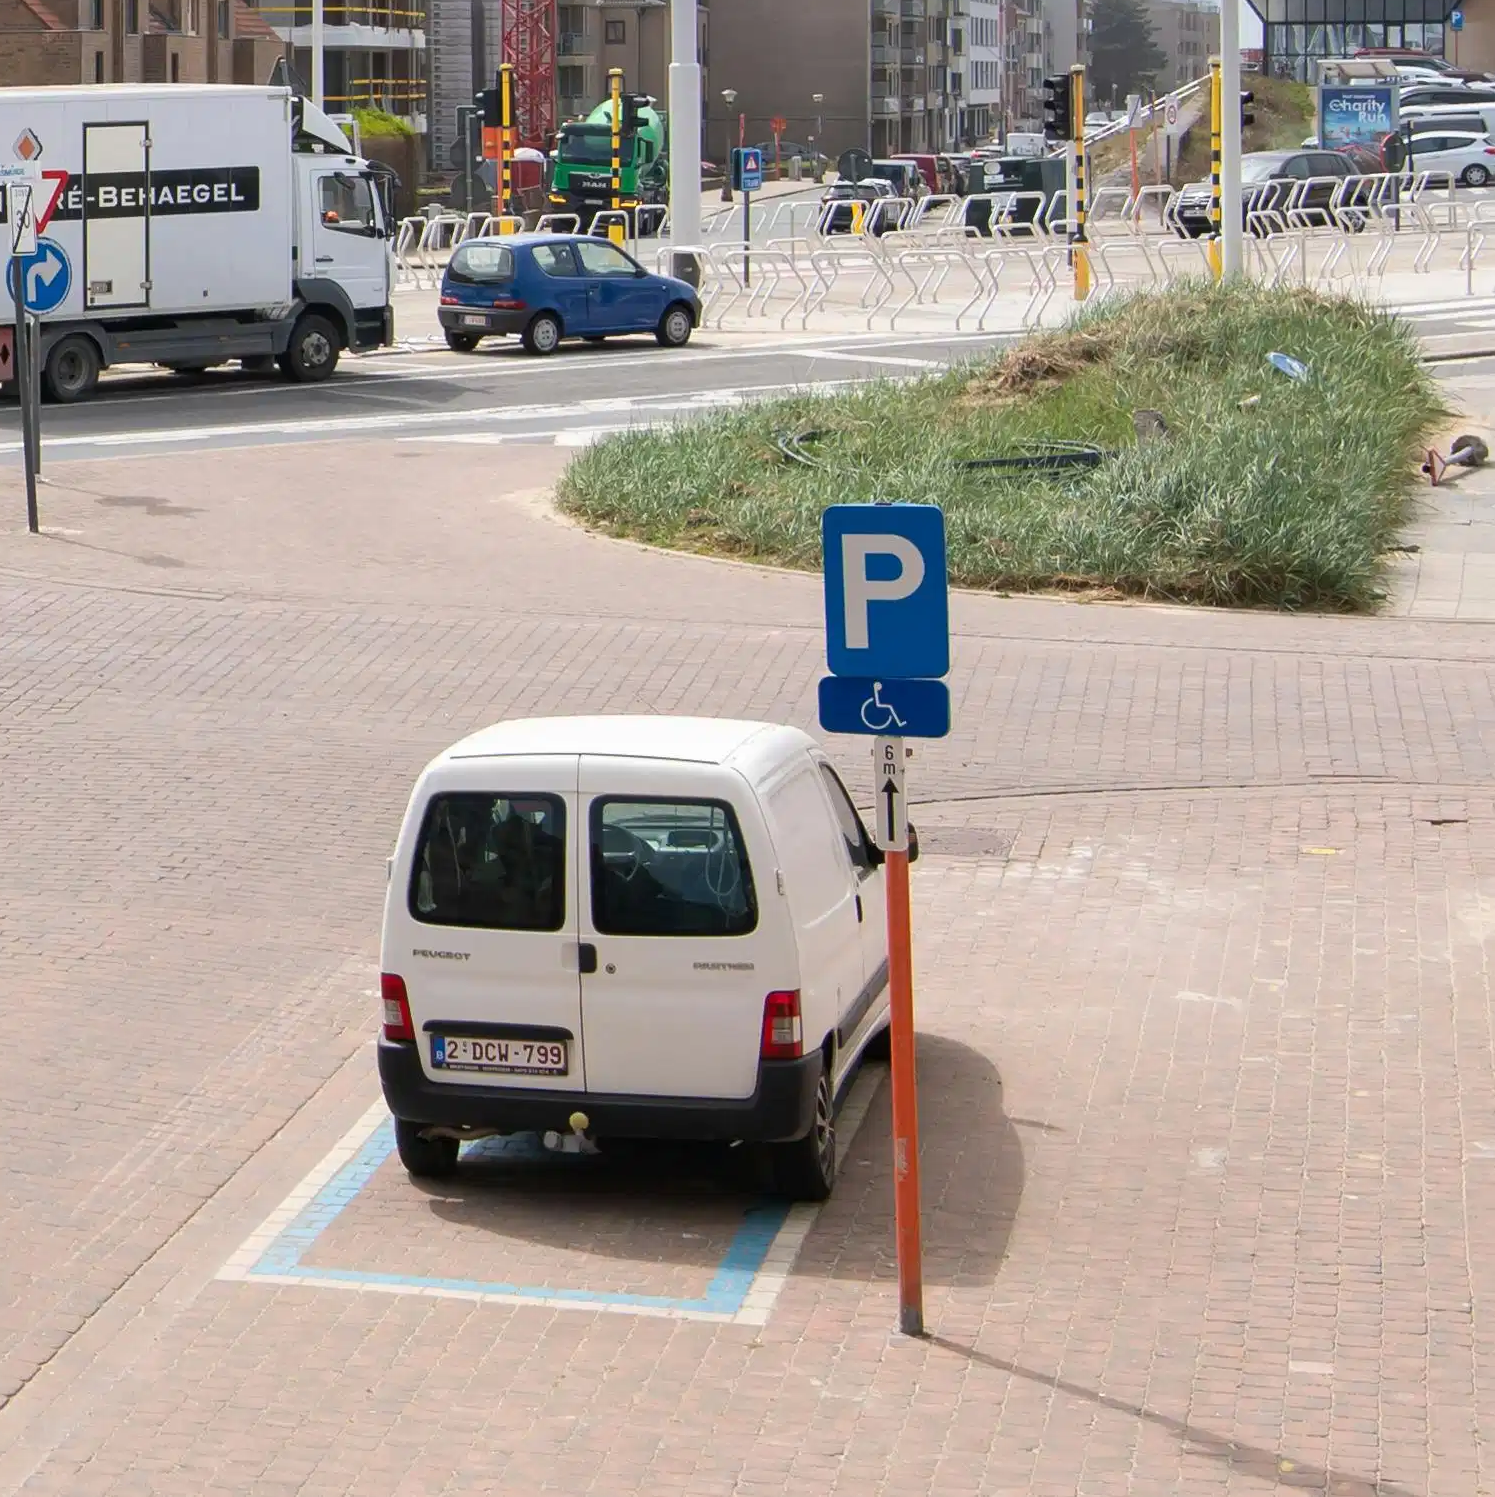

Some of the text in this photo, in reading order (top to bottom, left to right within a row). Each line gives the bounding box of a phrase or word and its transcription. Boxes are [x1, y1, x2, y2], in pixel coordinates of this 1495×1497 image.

[1452, 11, 1461, 23] P
[1358, 110, 1386, 123] Run
[16, 210, 30, 229] 30
[841, 533, 926, 649] P
[884, 744, 895, 761] 6
[883, 761, 896, 776] m
